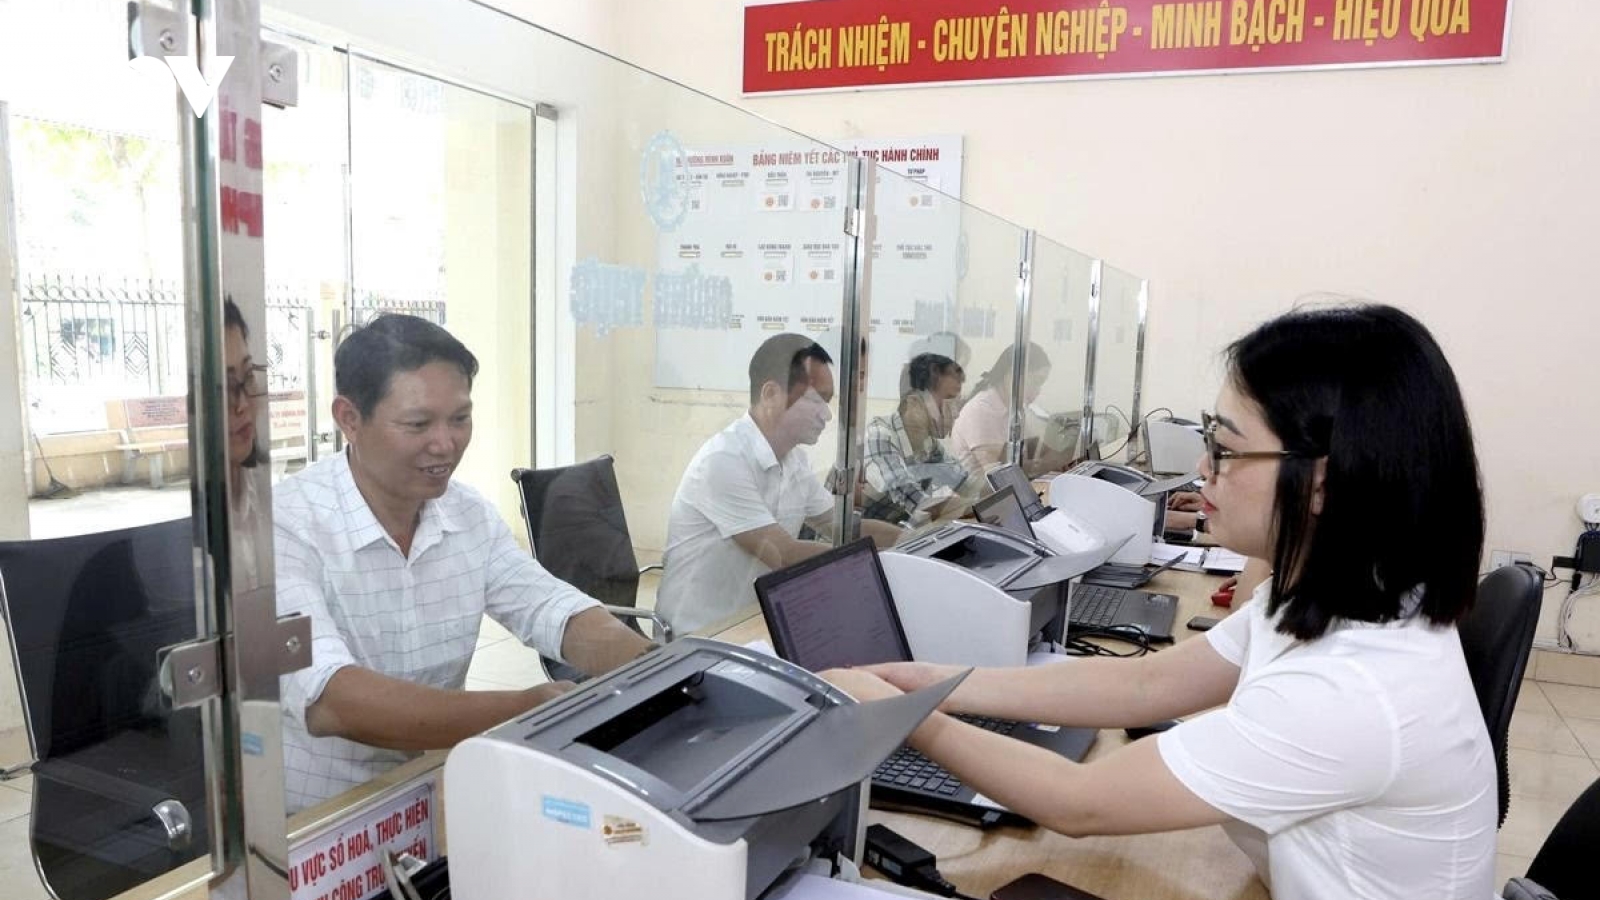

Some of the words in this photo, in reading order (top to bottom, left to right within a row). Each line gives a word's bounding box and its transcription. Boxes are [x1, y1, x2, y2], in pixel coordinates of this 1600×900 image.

[765, 22, 832, 72] TRÁCH
[838, 15, 911, 72] NHIỆM
[933, 6, 1028, 62] CHUYÊN
[1035, 0, 1128, 60] NGHIỆP
[1150, 1, 1222, 50] MINH
[1230, 0, 1308, 52] BẠCH
[752, 149, 777, 167] BẢNG
[822, 148, 841, 164] CÁC
[881, 146, 907, 162] HÀNH
[910, 144, 940, 161] CHÍNH
[301, 851, 326, 887] VỰC
[328, 832, 345, 872] SỐ
[347, 824, 373, 861] HOÁ,
[375, 812, 403, 846] THỰC
[404, 797, 428, 831] HIỆN
[364, 862, 386, 892] TRỰ
